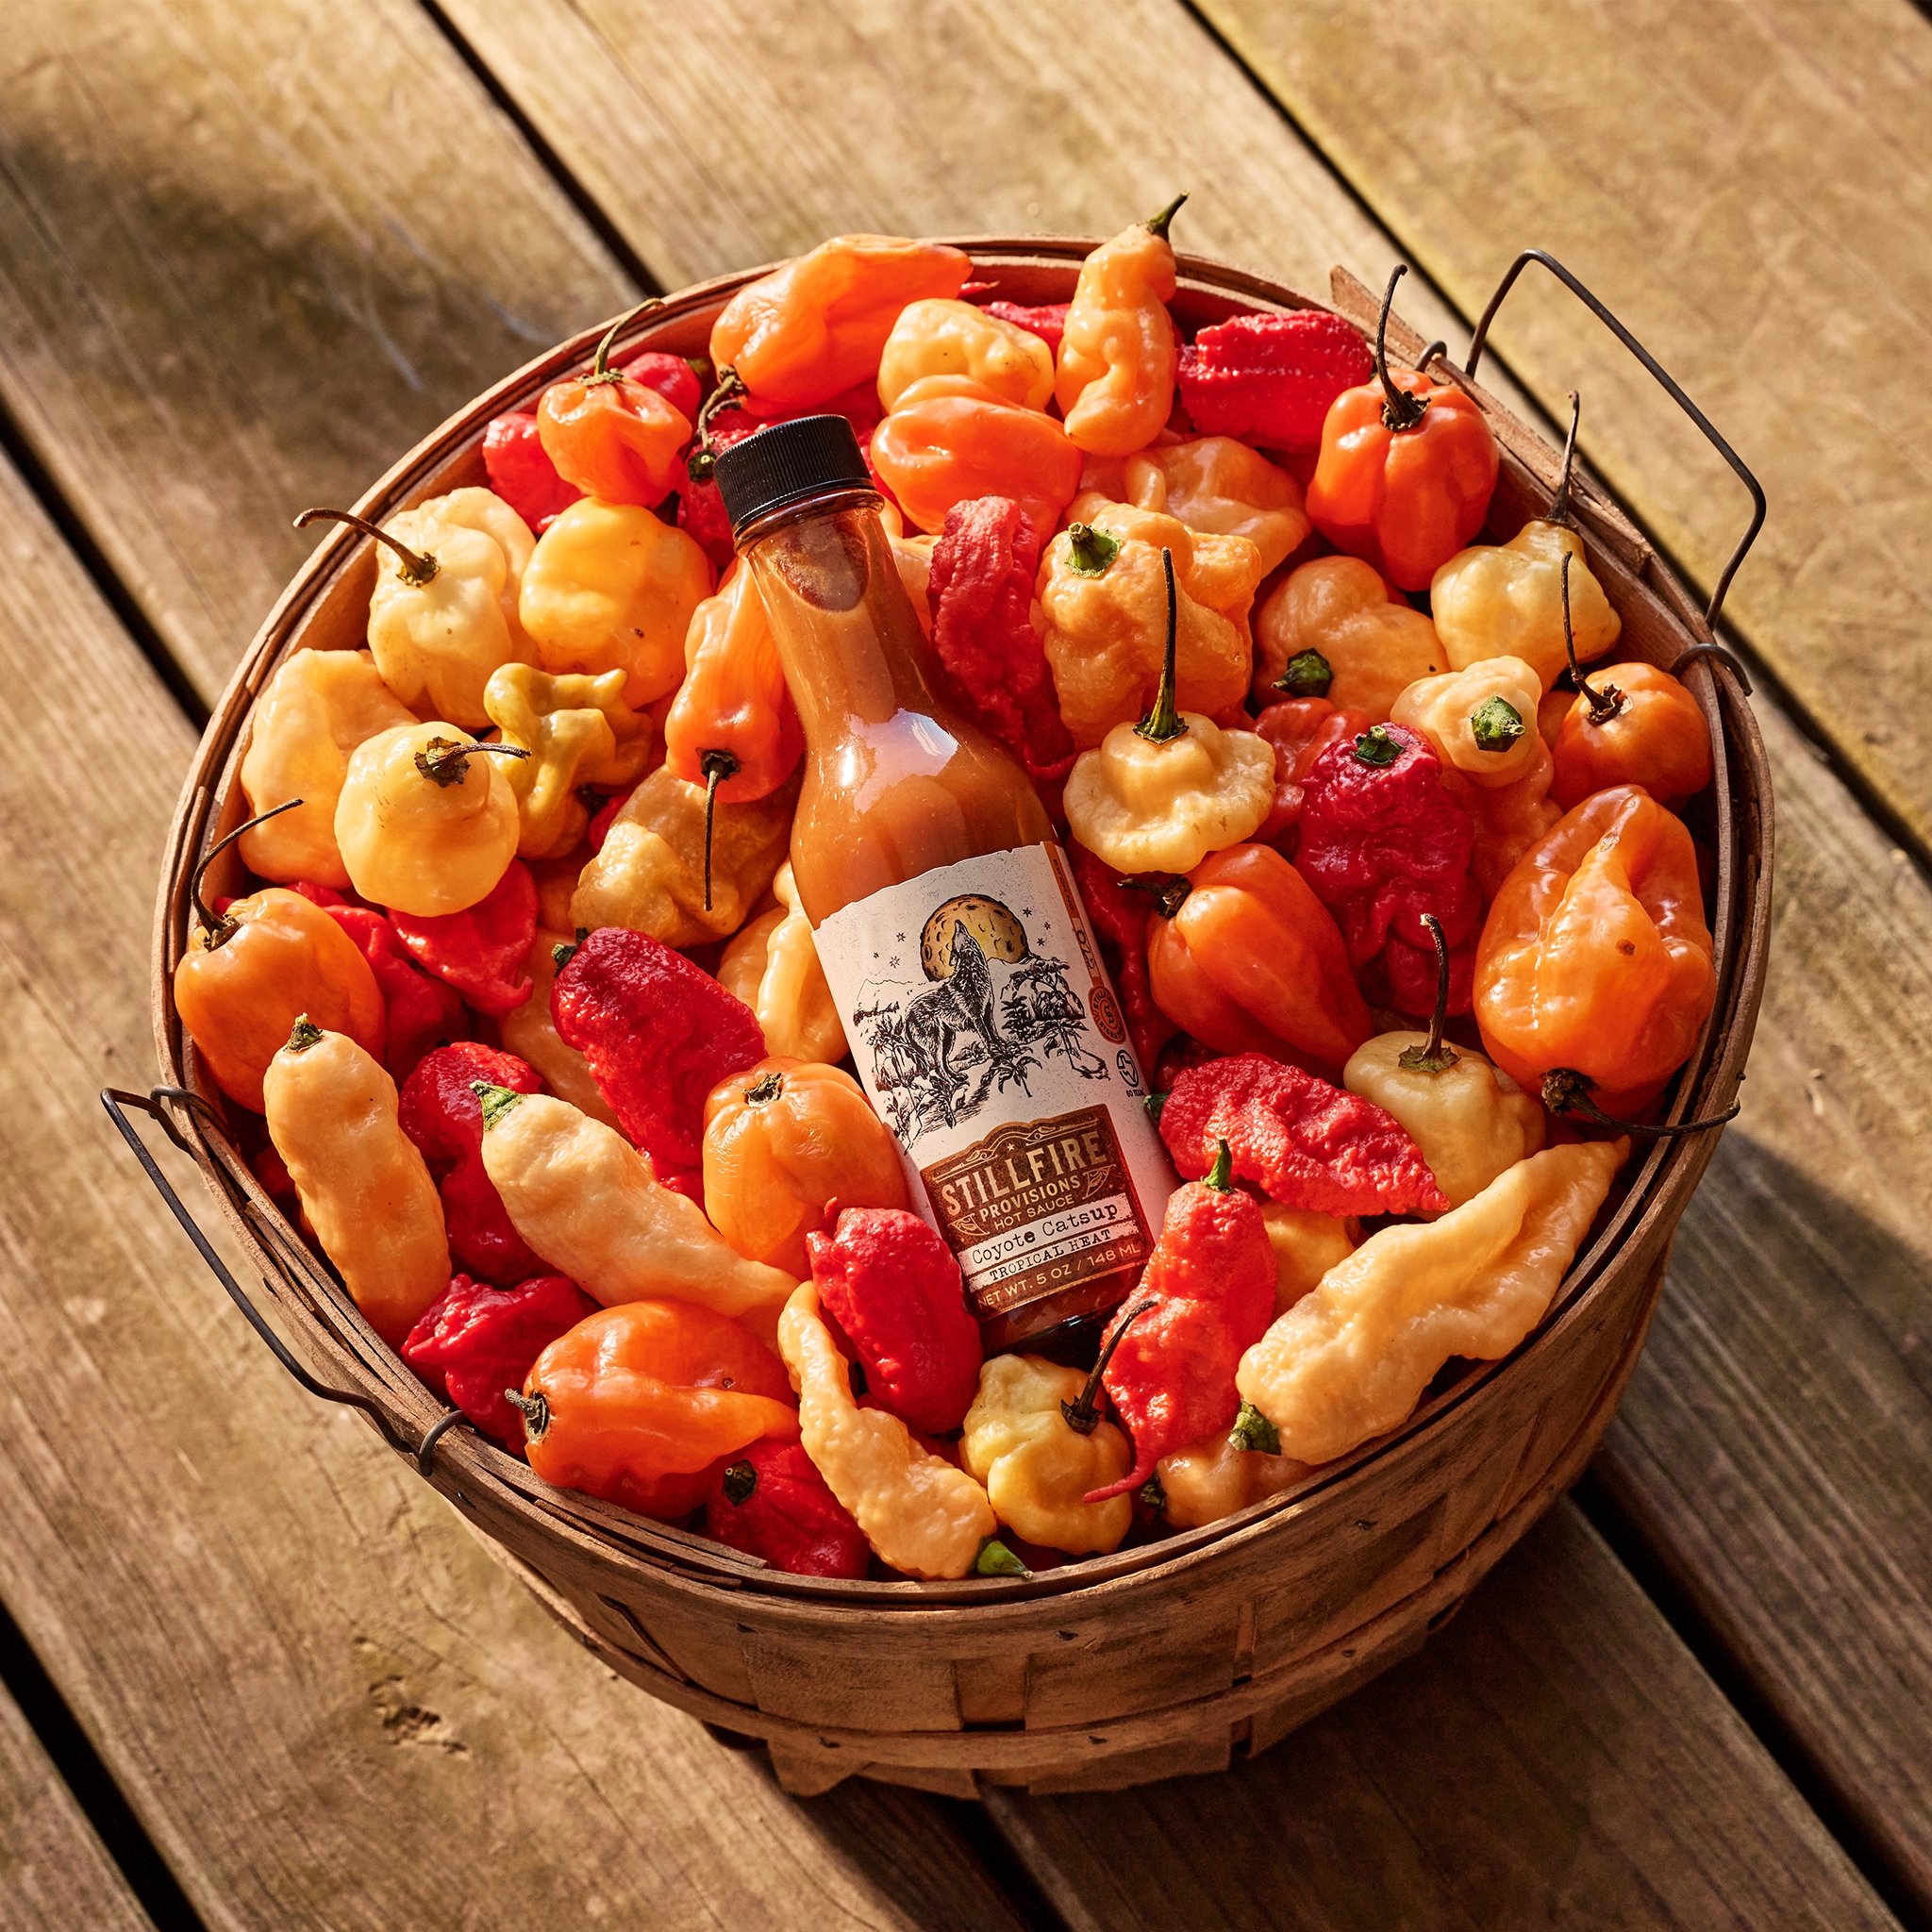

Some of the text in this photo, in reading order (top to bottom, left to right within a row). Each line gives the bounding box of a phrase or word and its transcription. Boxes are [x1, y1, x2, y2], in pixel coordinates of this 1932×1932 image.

[941, 1131, 1108, 1216] STILLFIRE
[978, 1174, 1081, 1223] PROVISIONS
[972, 1203, 1119, 1265] Coyote Catsup
[993, 1193, 1075, 1231] HOT SAUCE
[977, 1242, 1141, 1309] NET WT. 5 OZ / 148 ML
[990, 1228, 1111, 1281] TROPICAL HEAT
